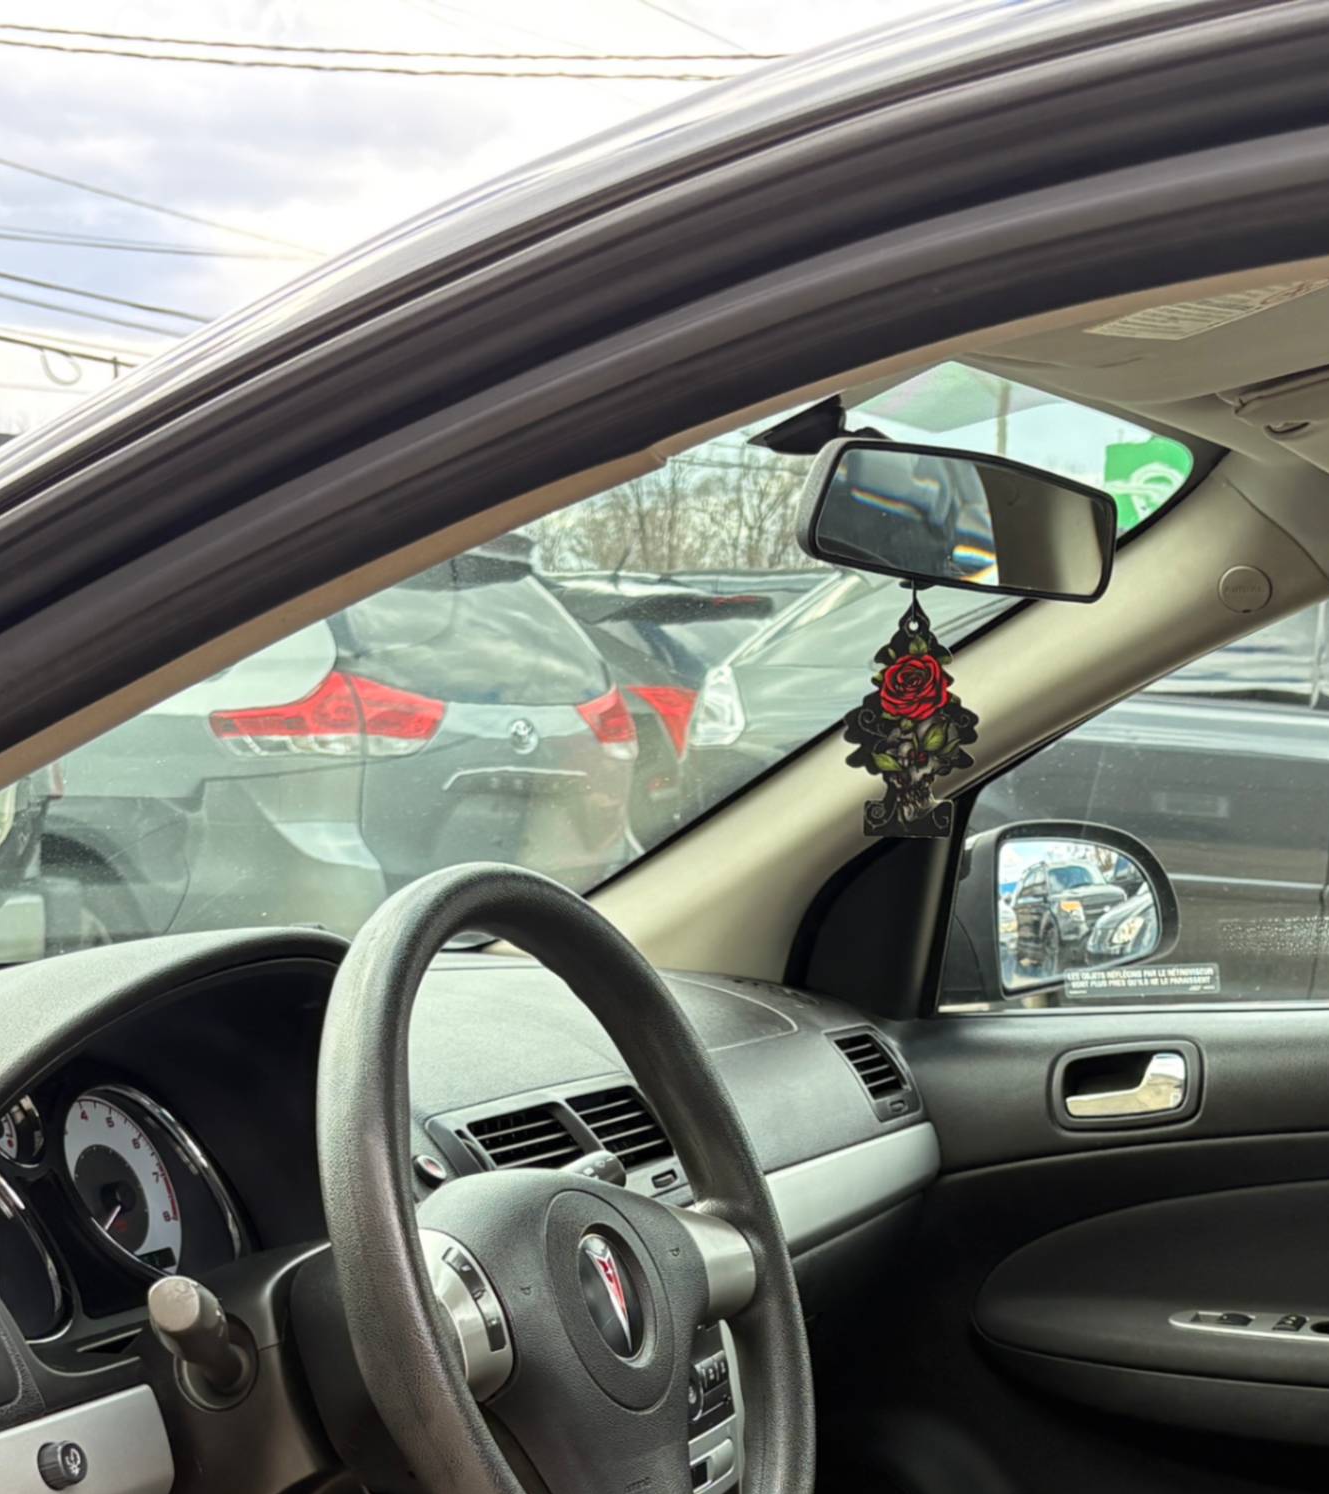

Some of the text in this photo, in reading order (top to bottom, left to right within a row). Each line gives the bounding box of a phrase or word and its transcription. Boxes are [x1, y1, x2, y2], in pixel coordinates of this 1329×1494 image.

[80, 1110, 89, 1121] 4
[105, 1116, 115, 1128] 5
[132, 1138, 141, 1149] 6
[152, 1172, 160, 1184] 7
[162, 1211, 171, 1222] 8
